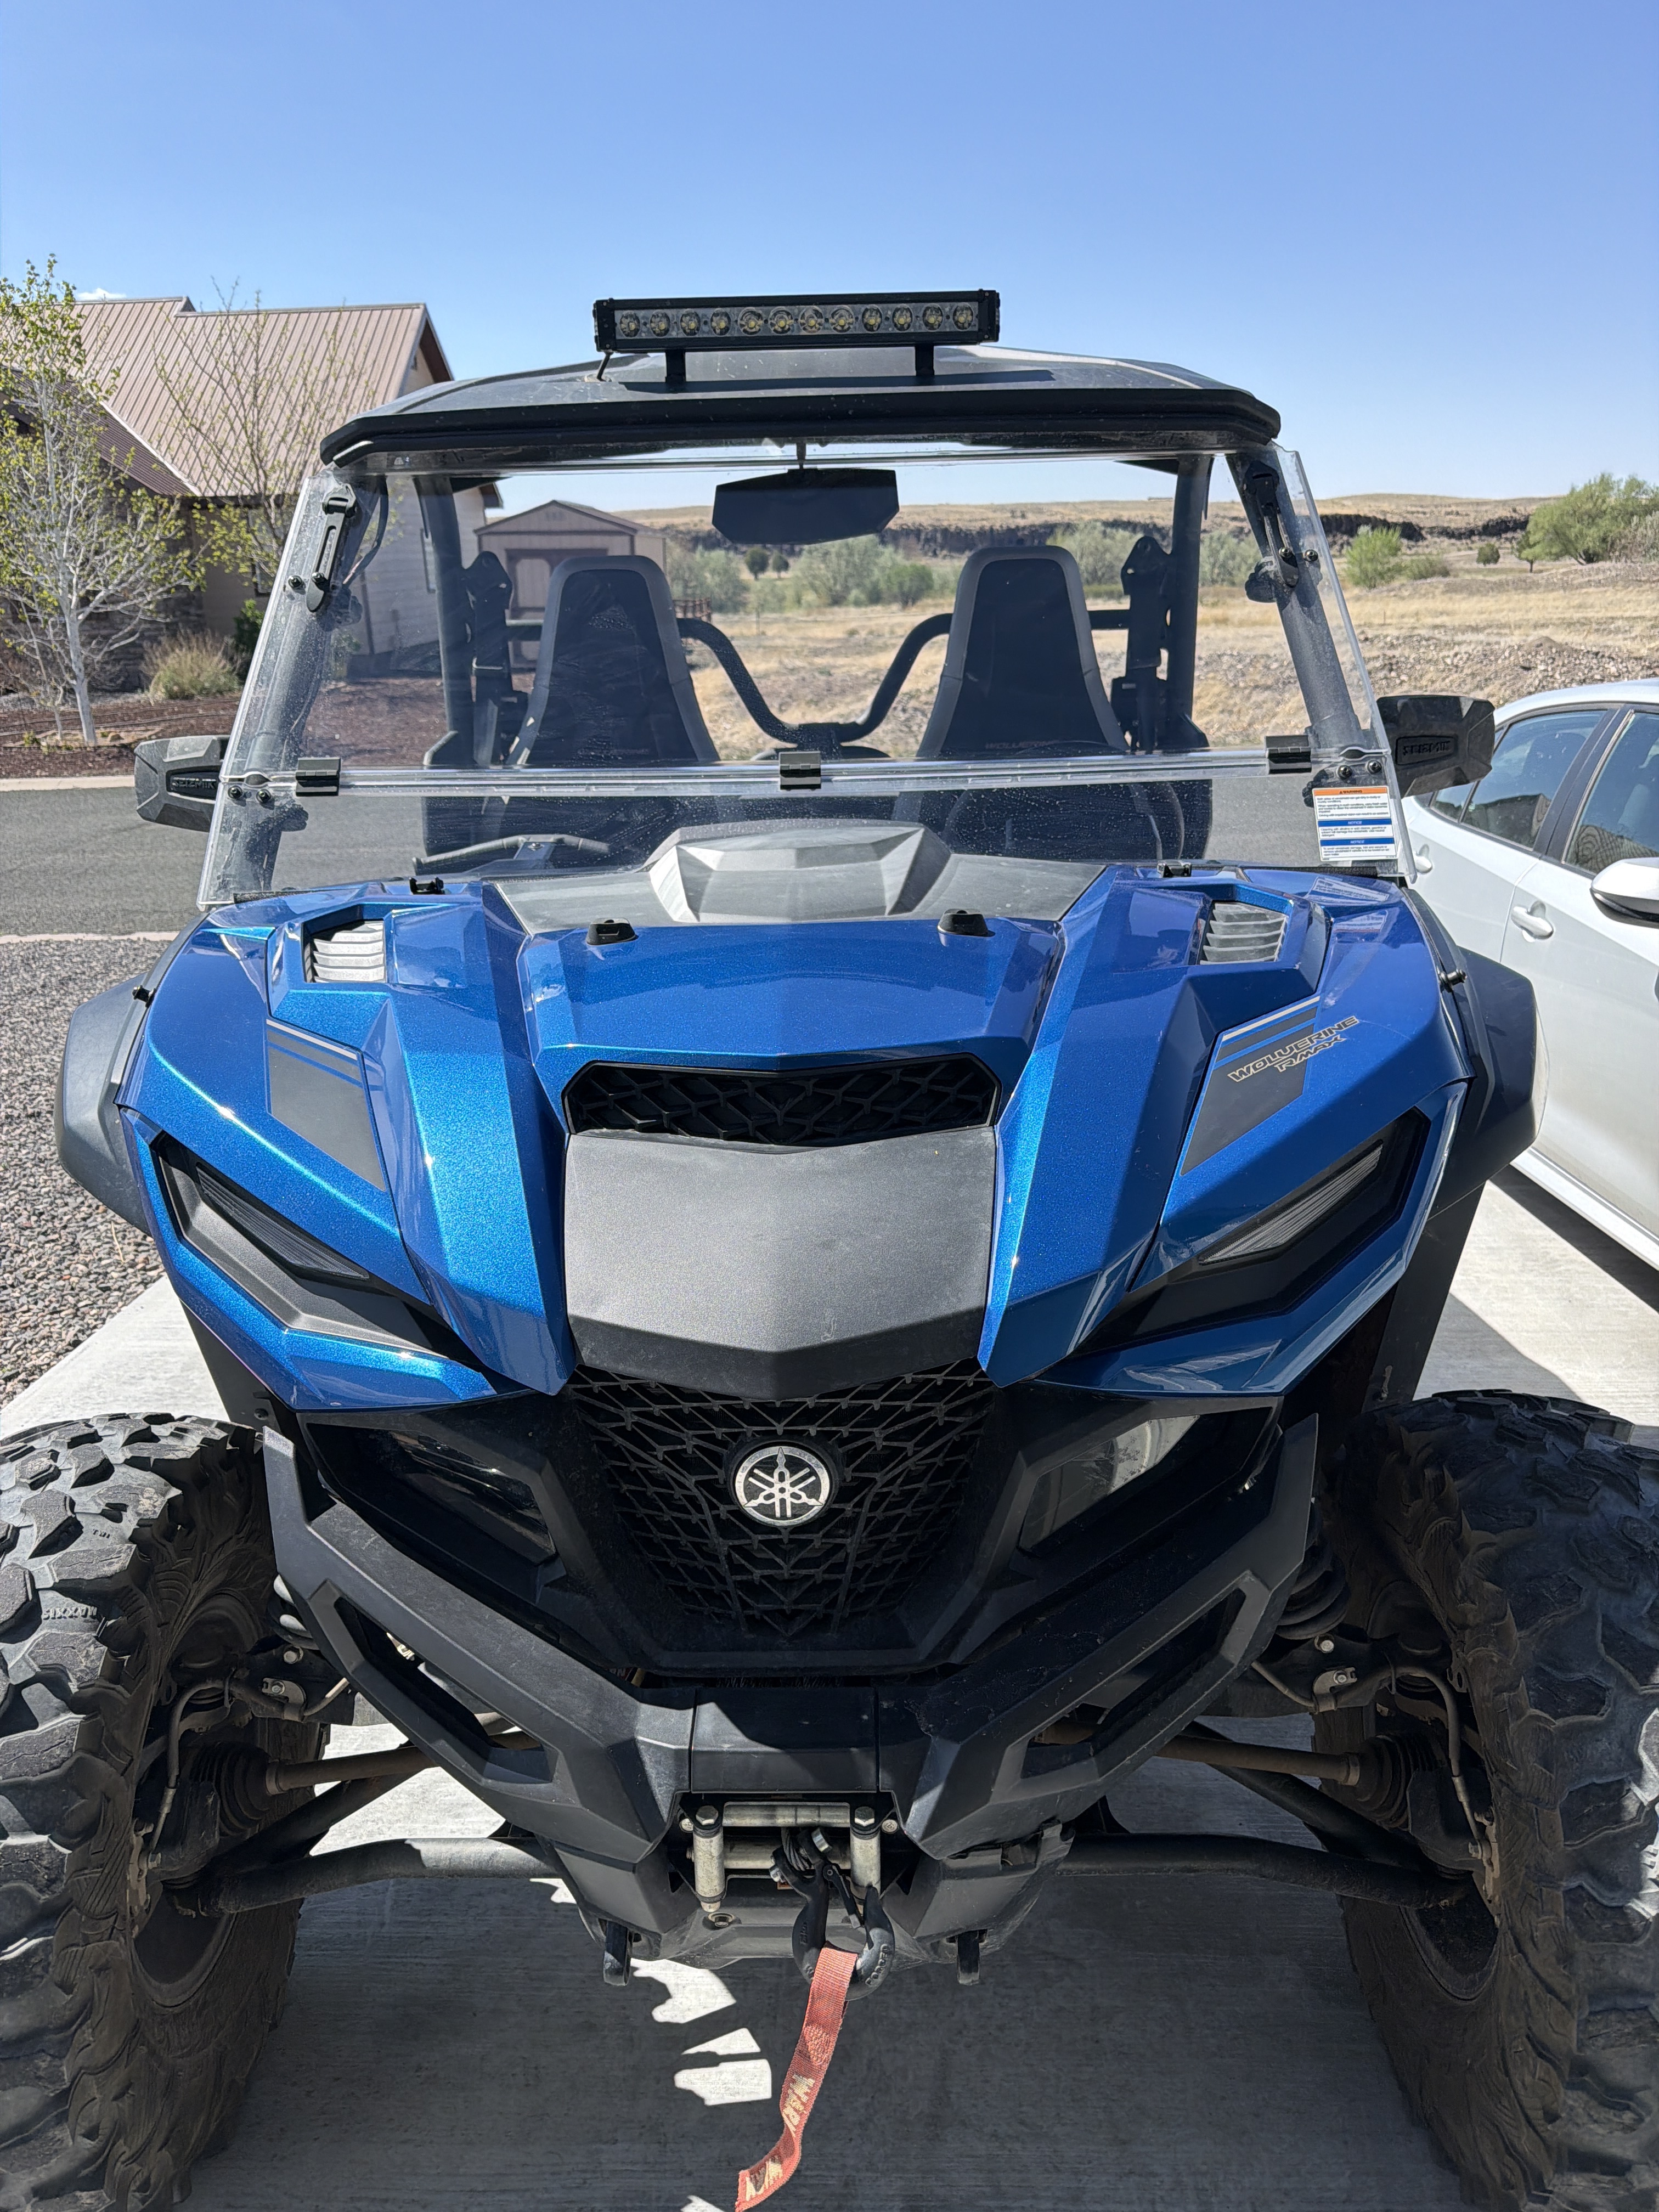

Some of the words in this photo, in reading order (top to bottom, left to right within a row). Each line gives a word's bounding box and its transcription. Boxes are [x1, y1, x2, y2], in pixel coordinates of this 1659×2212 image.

[1227, 1015, 1359, 1082] WOLVERINE
[43, 1606, 98, 1620] MAXXIS
[865, 1944, 890, 1986] FORGED
